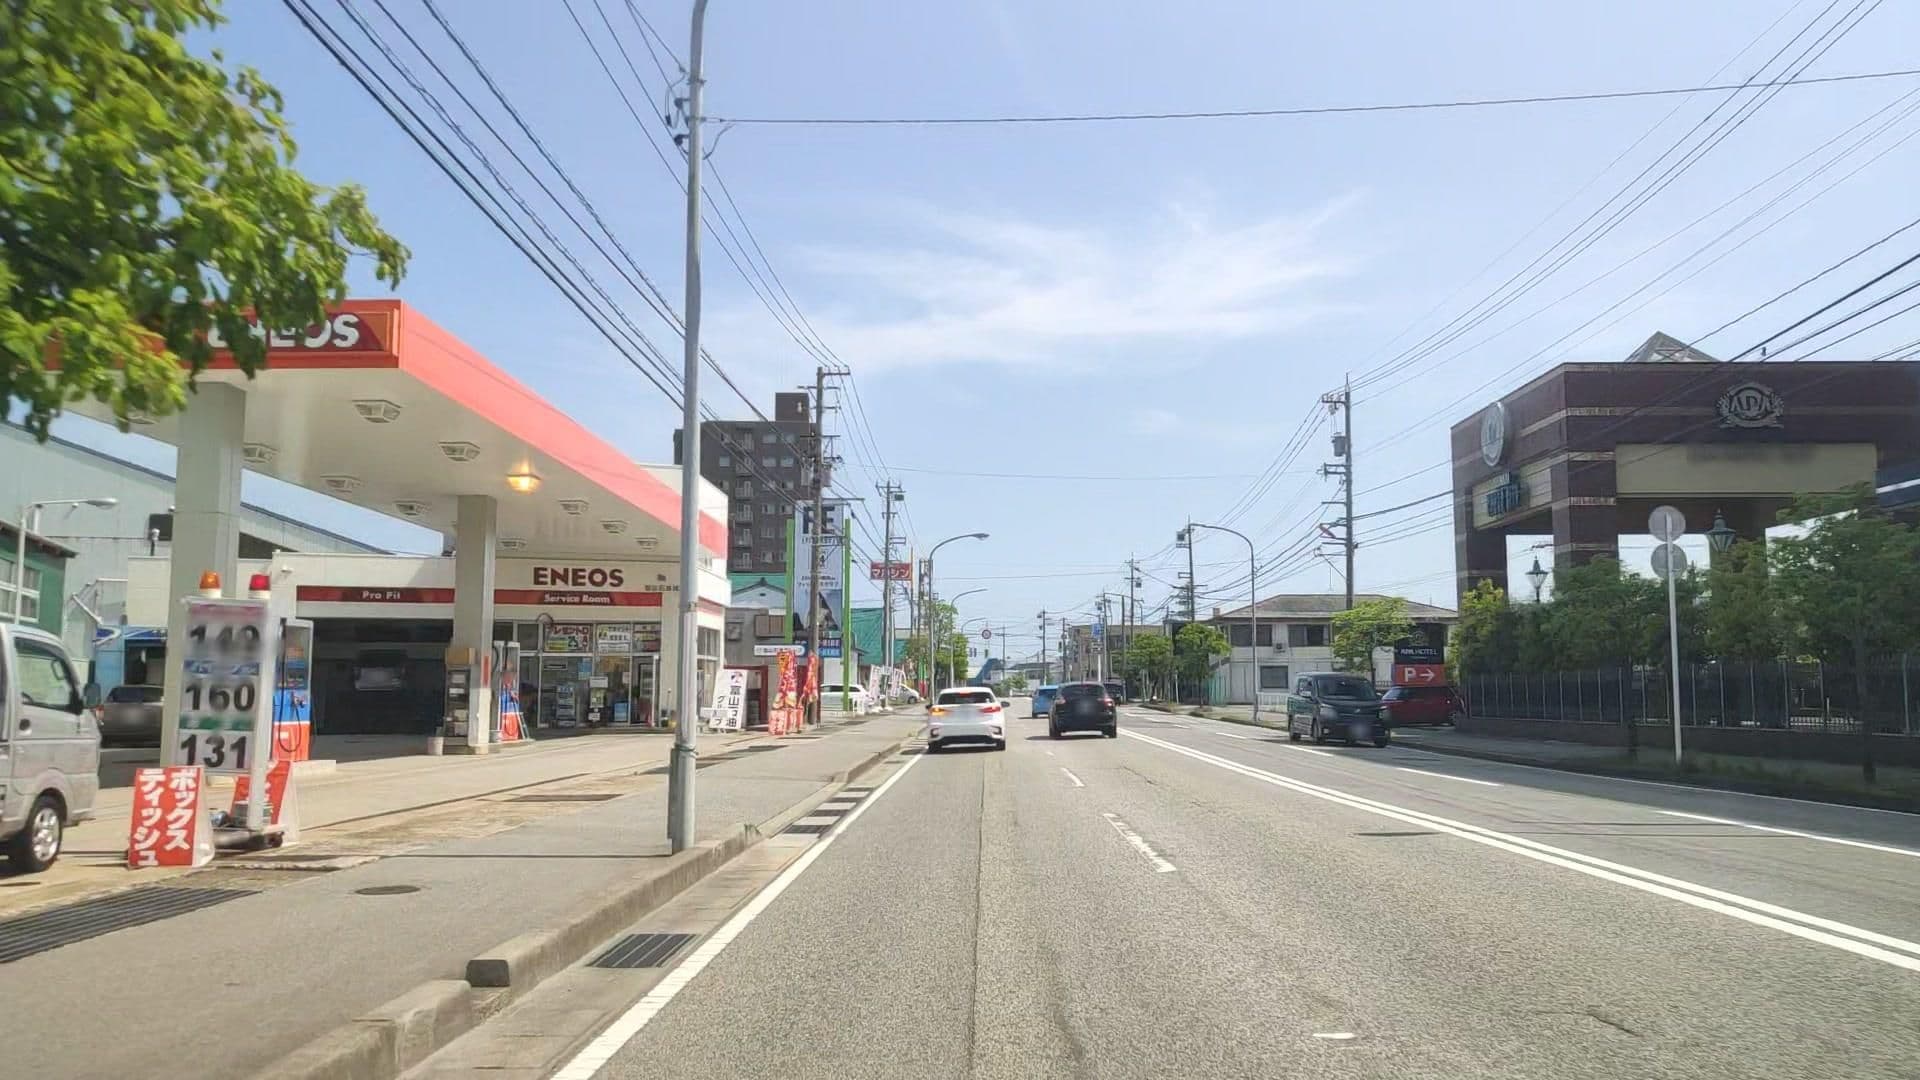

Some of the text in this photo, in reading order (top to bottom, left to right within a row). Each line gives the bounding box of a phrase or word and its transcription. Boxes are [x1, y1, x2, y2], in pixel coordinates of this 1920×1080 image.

[533, 567, 624, 587] ENEOS
[362, 590, 401, 600] Pro Fit
[544, 592, 611, 604] Service Room
[1405, 667, 1417, 682] P
[185, 682, 256, 712] 160
[180, 734, 247, 769] 131
[133, 769, 166, 866] ティッシュ
[164, 769, 198, 850] ボックス
